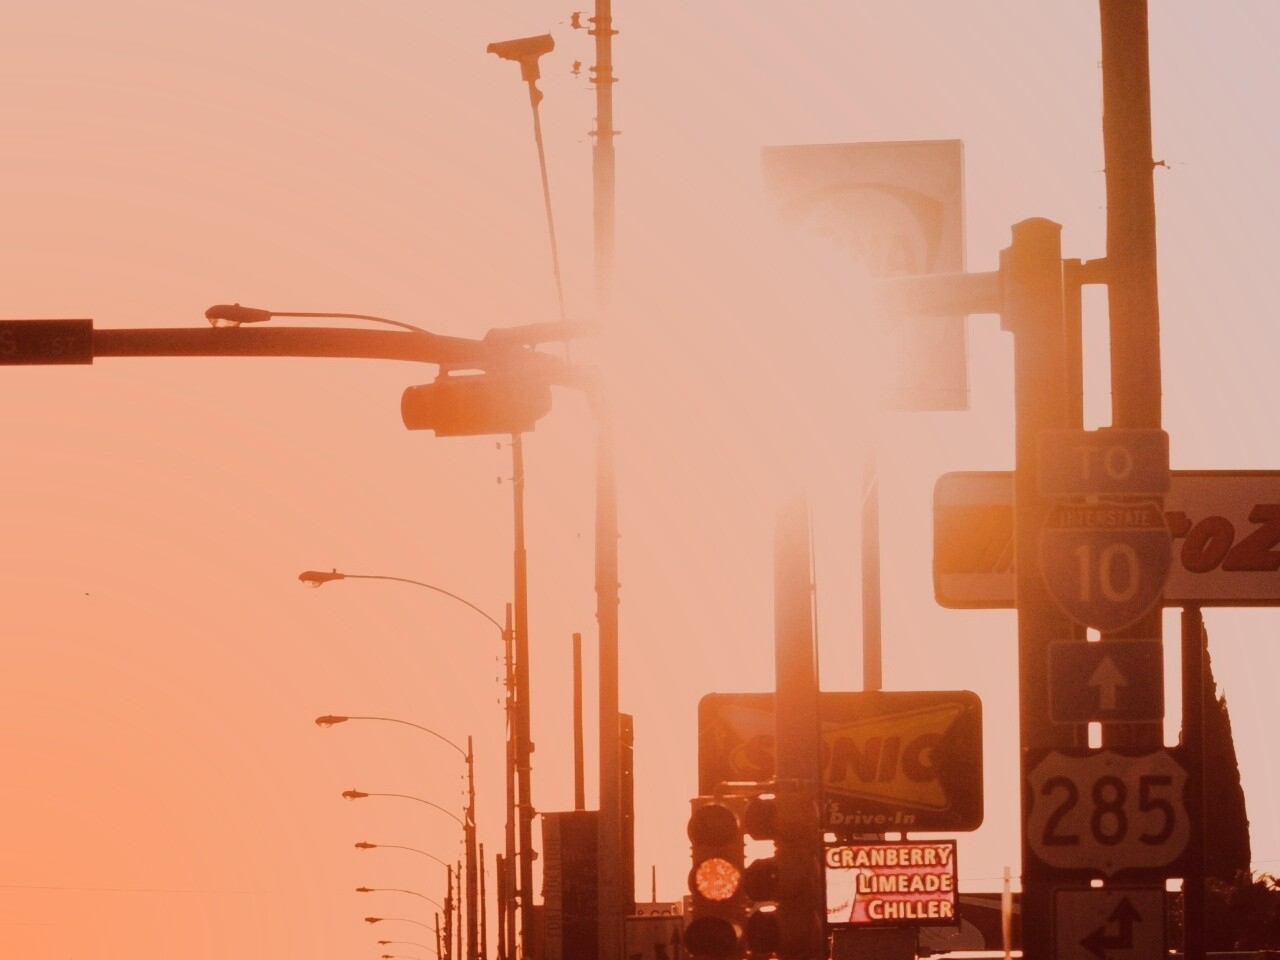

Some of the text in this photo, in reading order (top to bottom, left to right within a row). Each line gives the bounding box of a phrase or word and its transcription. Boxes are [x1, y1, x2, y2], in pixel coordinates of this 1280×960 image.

[1078, 444, 1133, 481] TO
[1073, 542, 1141, 603] 10
[742, 733, 945, 783] SNIC
[1040, 775, 1176, 846] 285
[825, 847, 952, 867] CRANBERRY
[858, 874, 953, 893] LIMEADE
[867, 899, 953, 919] CHILLER
